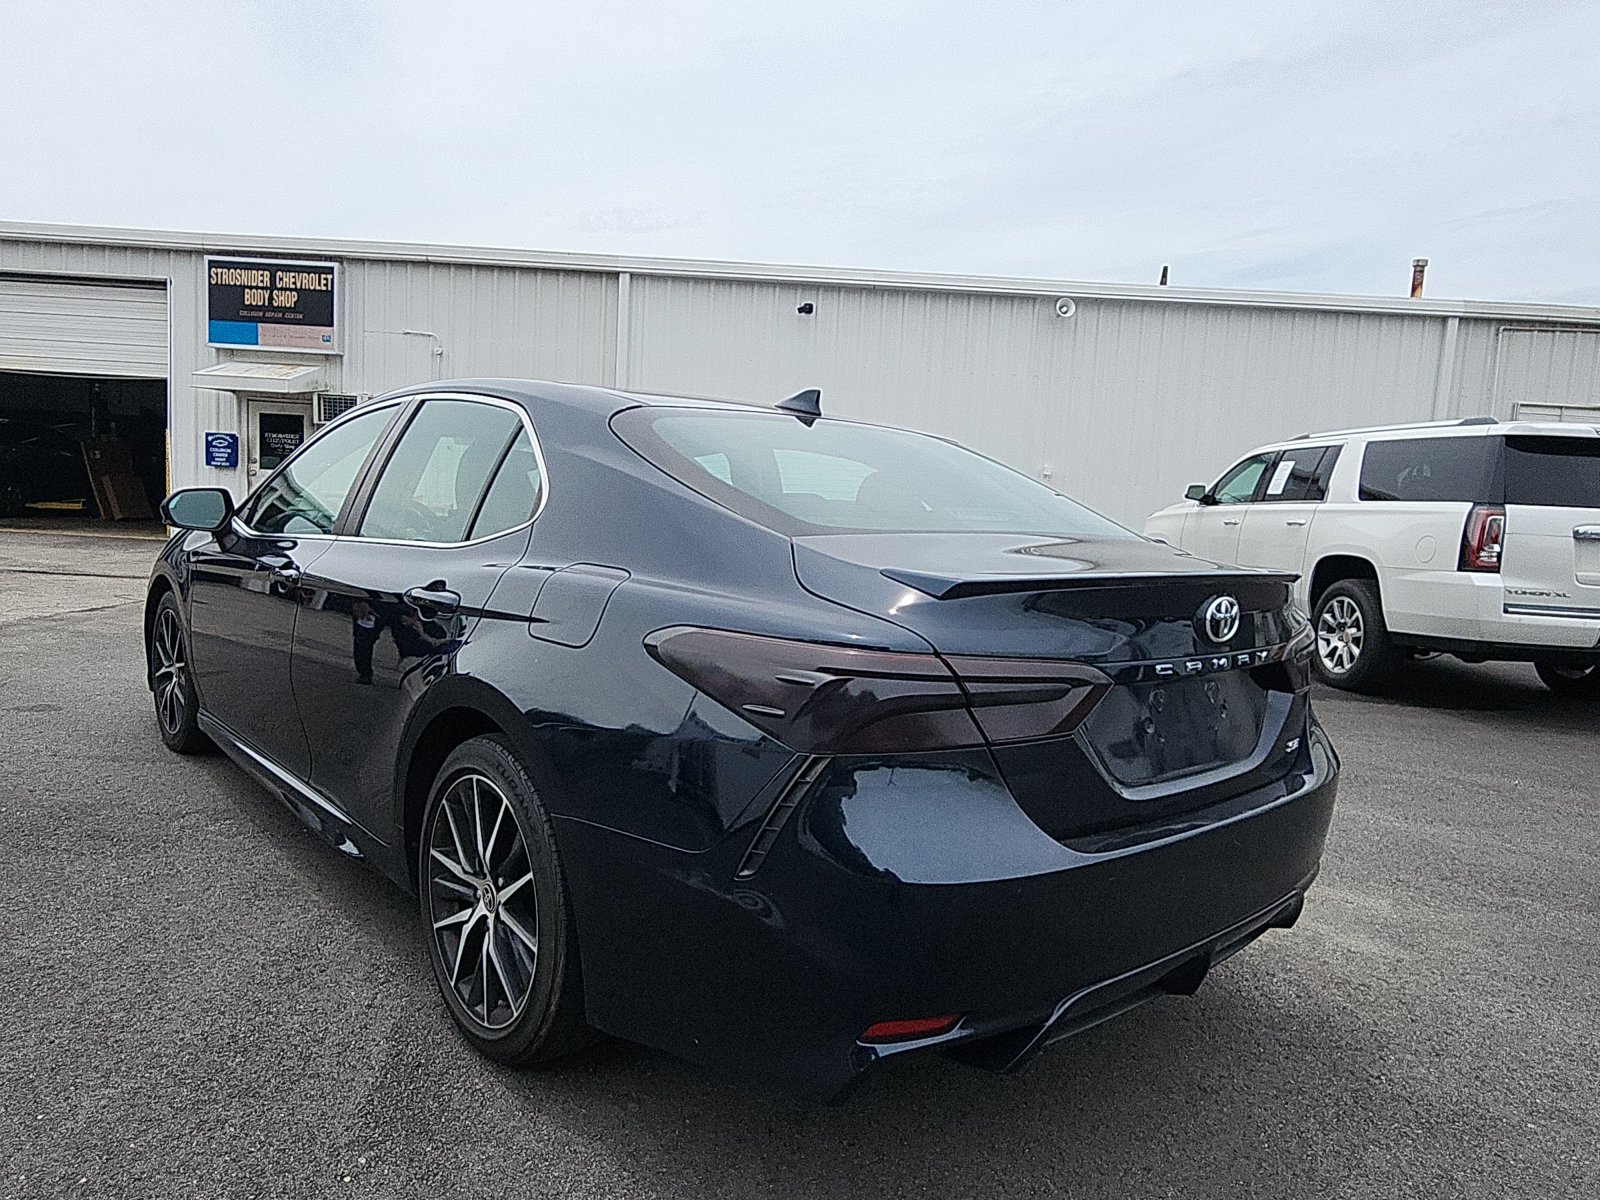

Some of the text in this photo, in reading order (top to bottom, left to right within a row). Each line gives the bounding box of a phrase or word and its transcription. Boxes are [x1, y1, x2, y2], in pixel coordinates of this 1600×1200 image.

[210, 268, 333, 291] STROSNIDER CHEVROLET
[244, 289, 298, 308] BODY SHOP
[1504, 587, 1551, 597] YUKON
[1155, 650, 1269, 675] CAMRY
